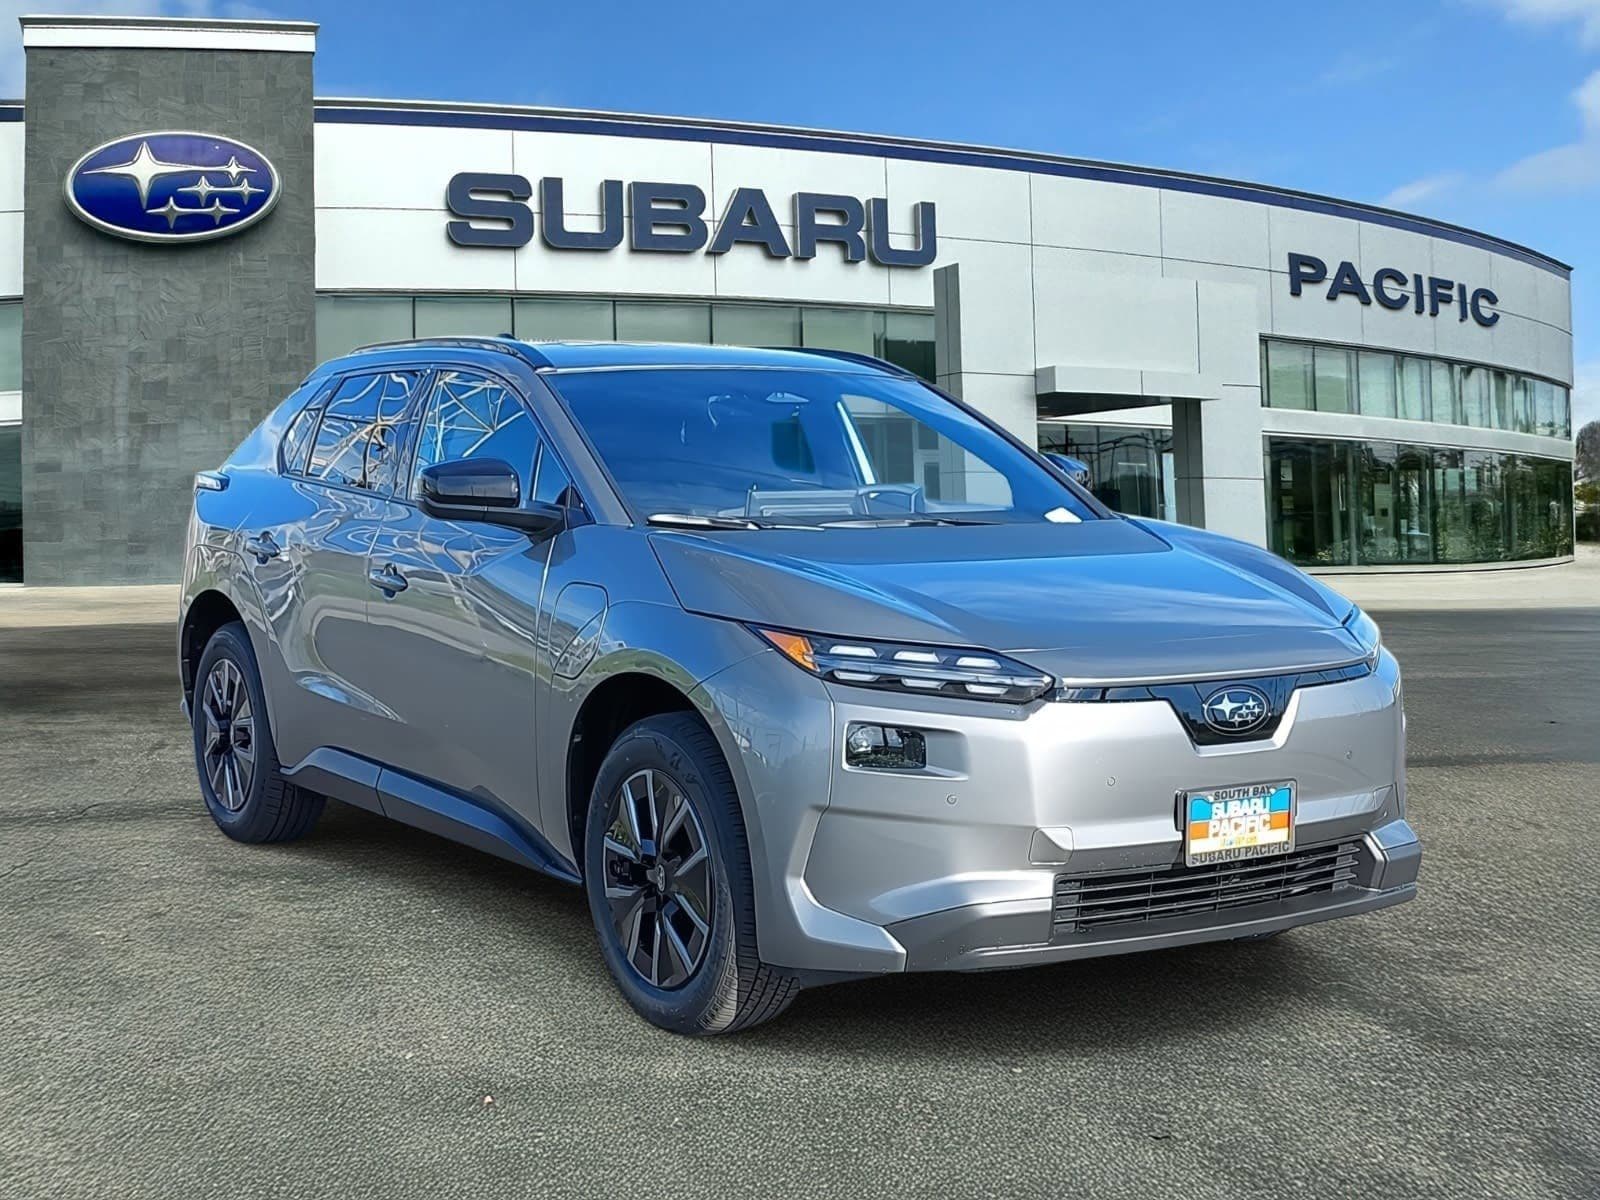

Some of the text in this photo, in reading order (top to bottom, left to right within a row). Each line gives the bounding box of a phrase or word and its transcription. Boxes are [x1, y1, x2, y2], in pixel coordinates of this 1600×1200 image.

[446, 172, 936, 267] SUBARU
[1288, 252, 1500, 327] PACIFIC
[1214, 785, 1271, 801] SOUTH BAY
[1211, 797, 1270, 820] SUBARU
[1208, 814, 1270, 839] PACIFIC
[1191, 848, 1240, 865] SUBARU
[1245, 841, 1290, 857] PACIFIC
